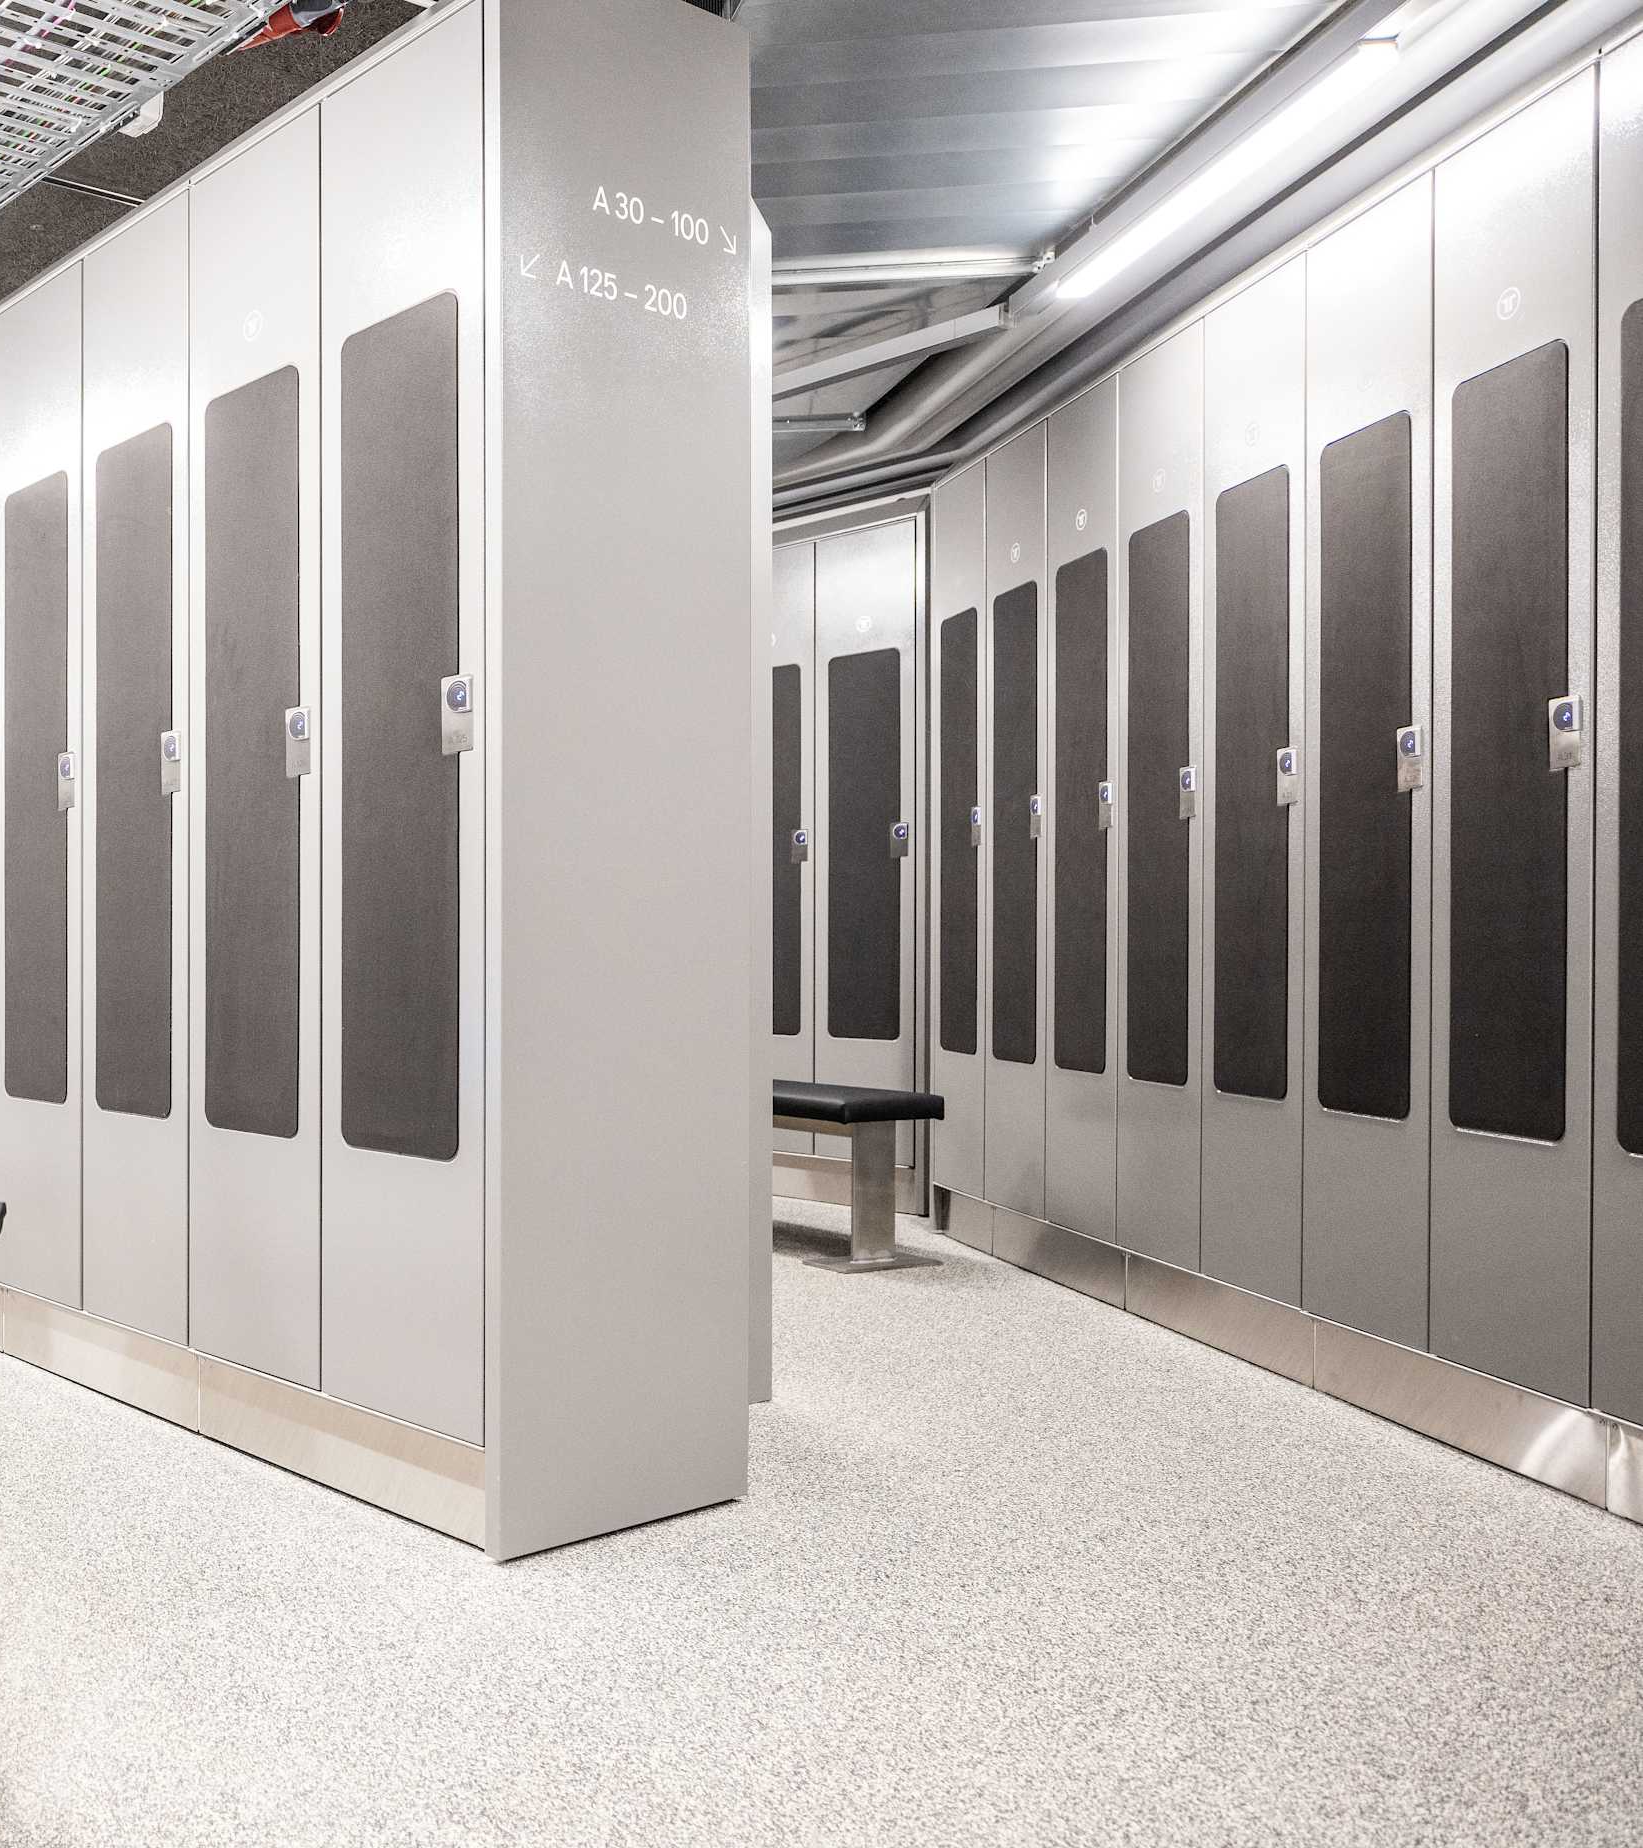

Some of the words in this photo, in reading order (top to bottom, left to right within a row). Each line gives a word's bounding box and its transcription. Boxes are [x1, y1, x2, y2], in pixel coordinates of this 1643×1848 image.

[592, 186, 611, 216] A
[615, 192, 645, 225] 30
[671, 210, 709, 245] 100
[556, 260, 574, 290] A
[579, 266, 619, 301] 125
[643, 285, 688, 320] 200
